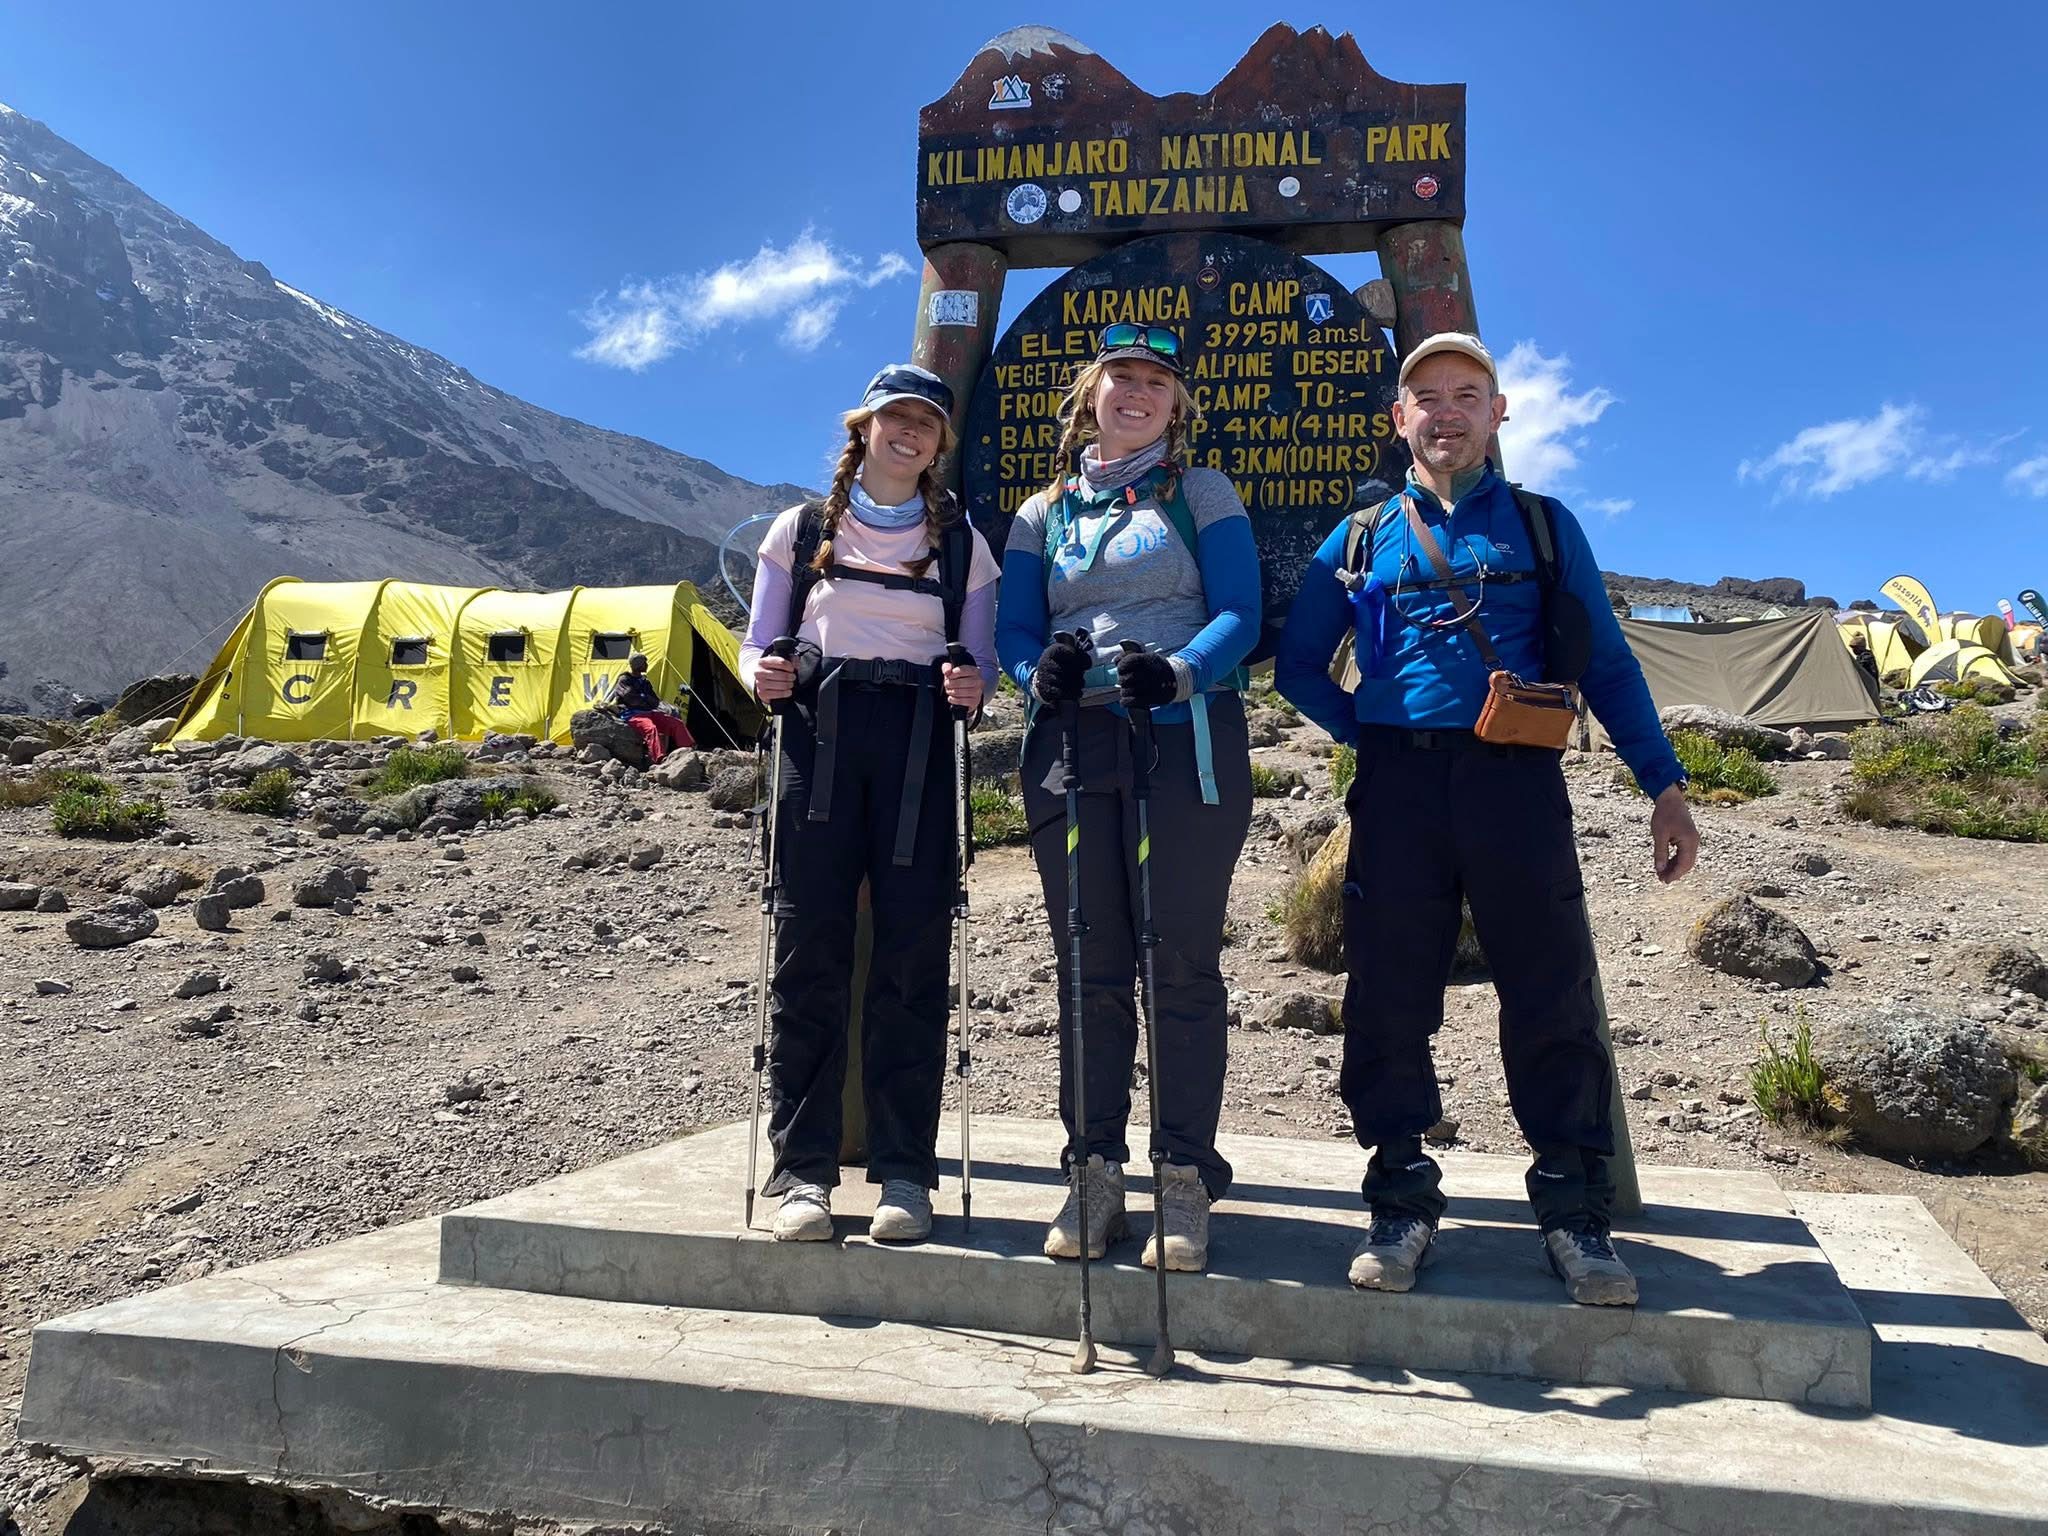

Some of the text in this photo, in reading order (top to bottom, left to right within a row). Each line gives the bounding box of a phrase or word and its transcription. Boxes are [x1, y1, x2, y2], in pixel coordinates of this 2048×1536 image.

[928, 122, 1451, 185] KILIMANJARO NATIONAL PARK
[1089, 175, 1249, 216] TANZANIA
[1062, 280, 1300, 325] KARANGA CAMP
[1205, 320, 1299, 349] 3995M
[1307, 319, 1372, 344] amsl
[1292, 348, 1385, 376] DESERT
[1000, 391, 1065, 420] FROM
[1197, 382, 1271, 412] CAMP
